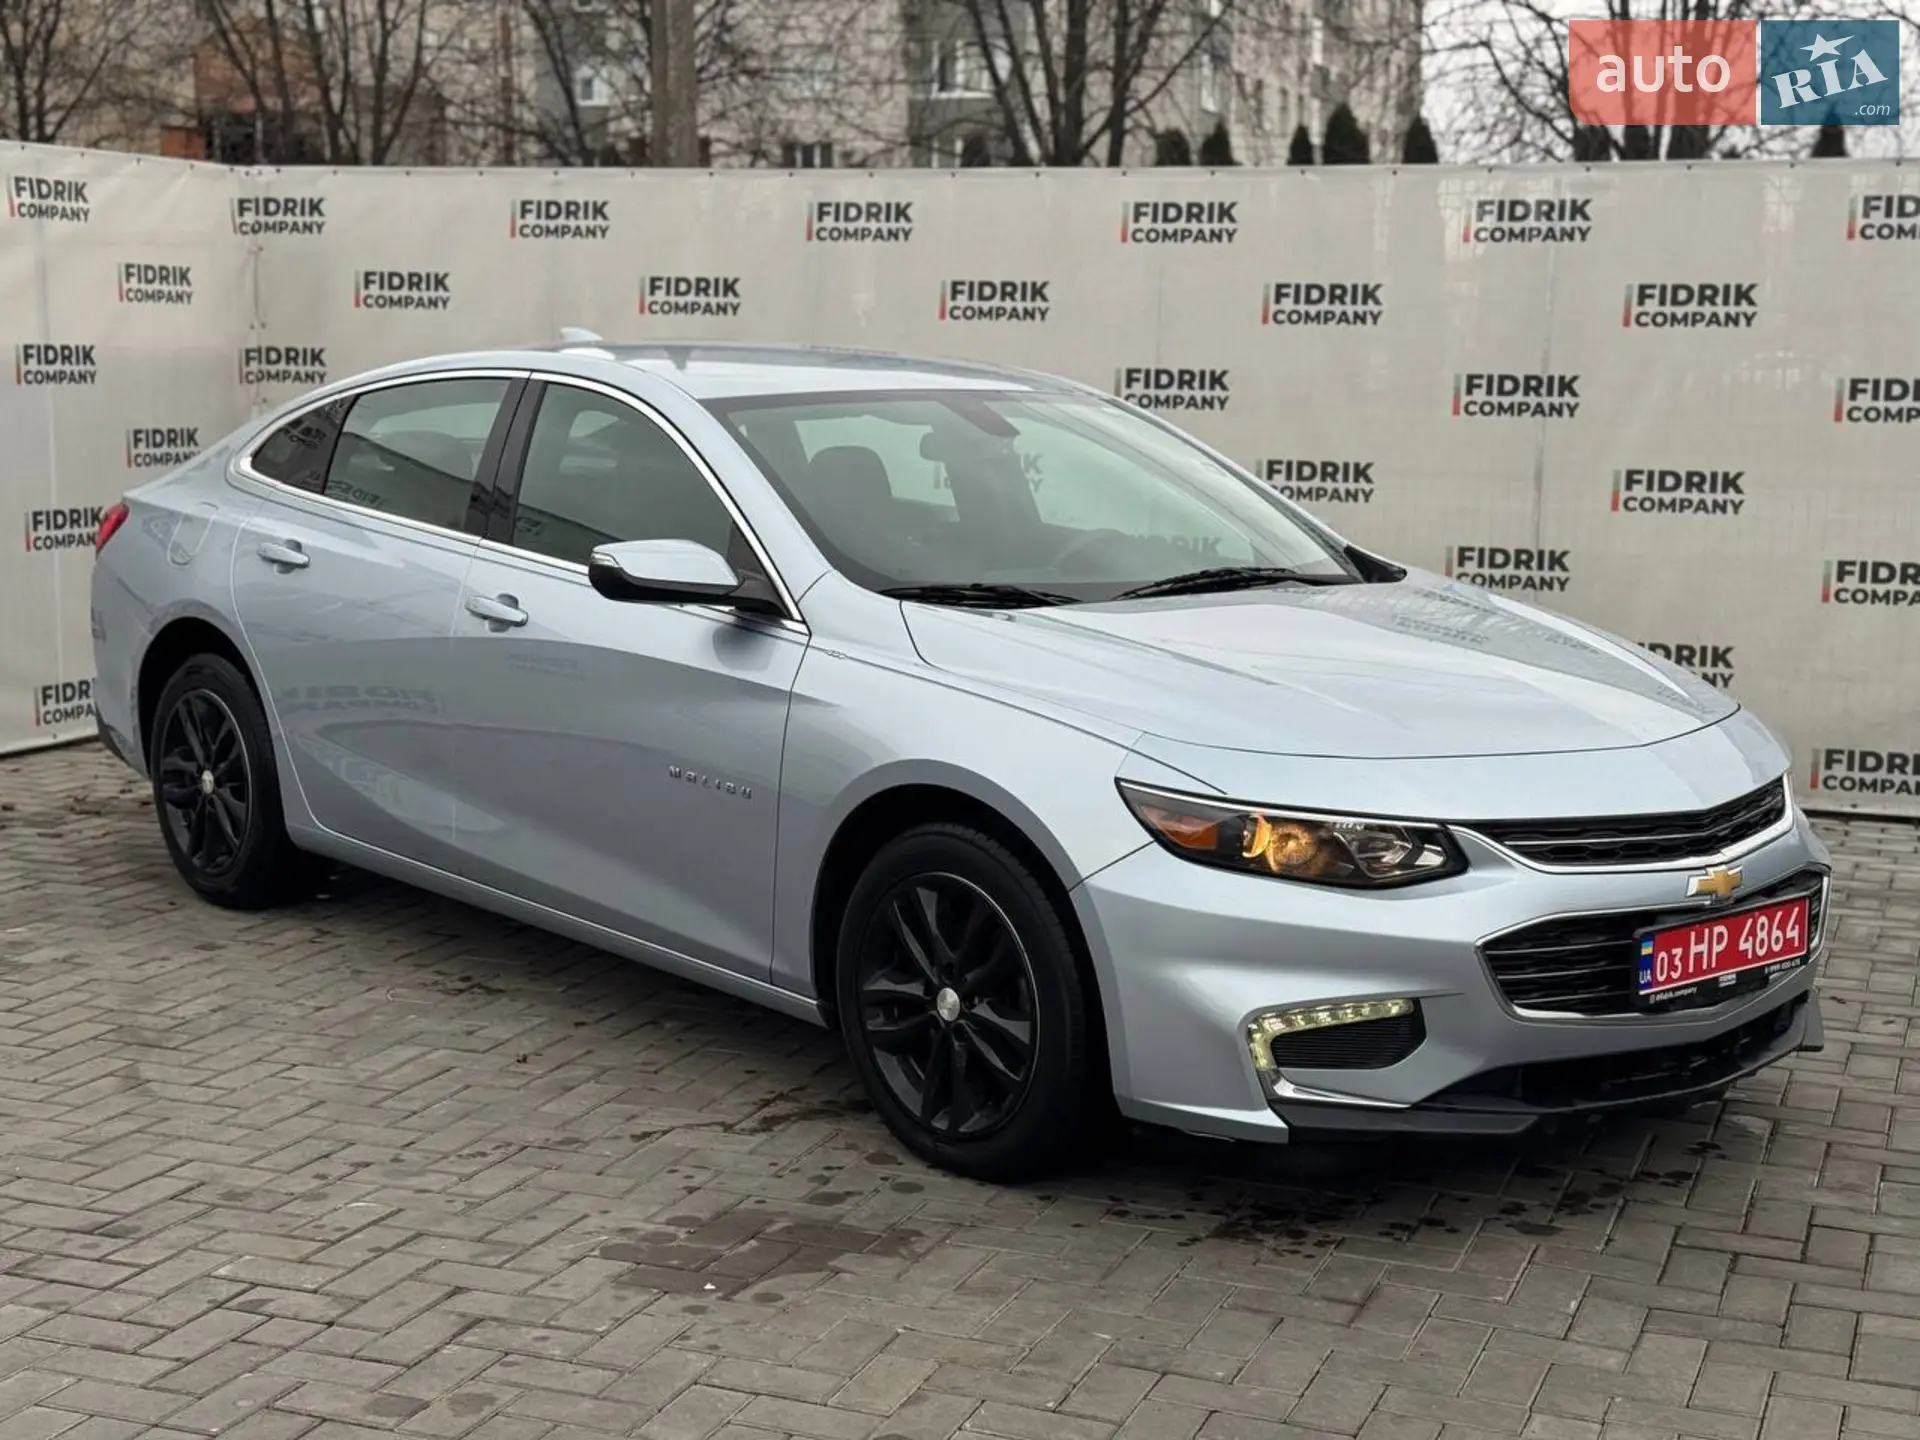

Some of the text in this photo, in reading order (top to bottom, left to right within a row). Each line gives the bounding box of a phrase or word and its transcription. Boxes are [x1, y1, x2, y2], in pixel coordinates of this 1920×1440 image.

[14, 176, 88, 204] FIDRIK
[16, 201, 91, 223] COMPANY
[237, 196, 326, 218] FIDRIK
[519, 200, 610, 222] FIDRIK
[816, 202, 913, 224] FIDRIK
[1132, 202, 1238, 224] FIDRIK
[1476, 198, 1592, 223] FIDRIK
[1862, 195, 1920, 219] FID
[237, 218, 326, 235] COMPANY
[518, 221, 610, 239] COMPANY
[815, 226, 913, 243] COMPANY
[1131, 226, 1238, 244] COMPANY
[1474, 225, 1592, 244] COMPANY
[124, 263, 192, 287] FIDRIK
[363, 271, 450, 293] FIDRIK
[124, 285, 193, 304] COMPANY
[648, 277, 741, 298] FIDRIK
[949, 280, 1050, 303] FIDRIK
[1273, 283, 1383, 307] FIDRIK
[1637, 283, 1758, 307] FIDRIK
[363, 293, 450, 310] COMPANY
[647, 300, 741, 317] COMPANY
[948, 305, 1050, 322] COMPANY
[1272, 309, 1383, 326] COMPANY
[1634, 310, 1757, 329] COMPANY
[23, 344, 95, 368] FIDRIK
[244, 346, 327, 368] FIDRIK
[23, 366, 96, 386] COMPANY
[243, 367, 327, 385] COMPANY
[1125, 368, 1229, 391] FIDRIK
[1464, 374, 1580, 399] FIDRIK
[1848, 378, 1920, 402] FID
[1463, 400, 1579, 419] COMPANY
[1846, 406, 1920, 423] COMP
[133, 427, 199, 448] FIDRIK
[1266, 460, 1374, 484] FIDRIK
[1623, 469, 1745, 496] FIDRIK
[1622, 497, 1744, 516] COMPANY
[31, 506, 103, 532] FIDRIK
[33, 532, 97, 551] COMPAN
[1457, 546, 1570, 572] FIDRIK
[1836, 560, 1920, 586] FIDR
[41, 678, 95, 706] FIDR
[43, 702, 97, 725] COMPA
[1824, 749, 1920, 777] FIDRI
[1822, 775, 1920, 797] COMPA
[1656, 906, 1800, 983] 03 HP 4864
[1639, 969, 1652, 985] UA
